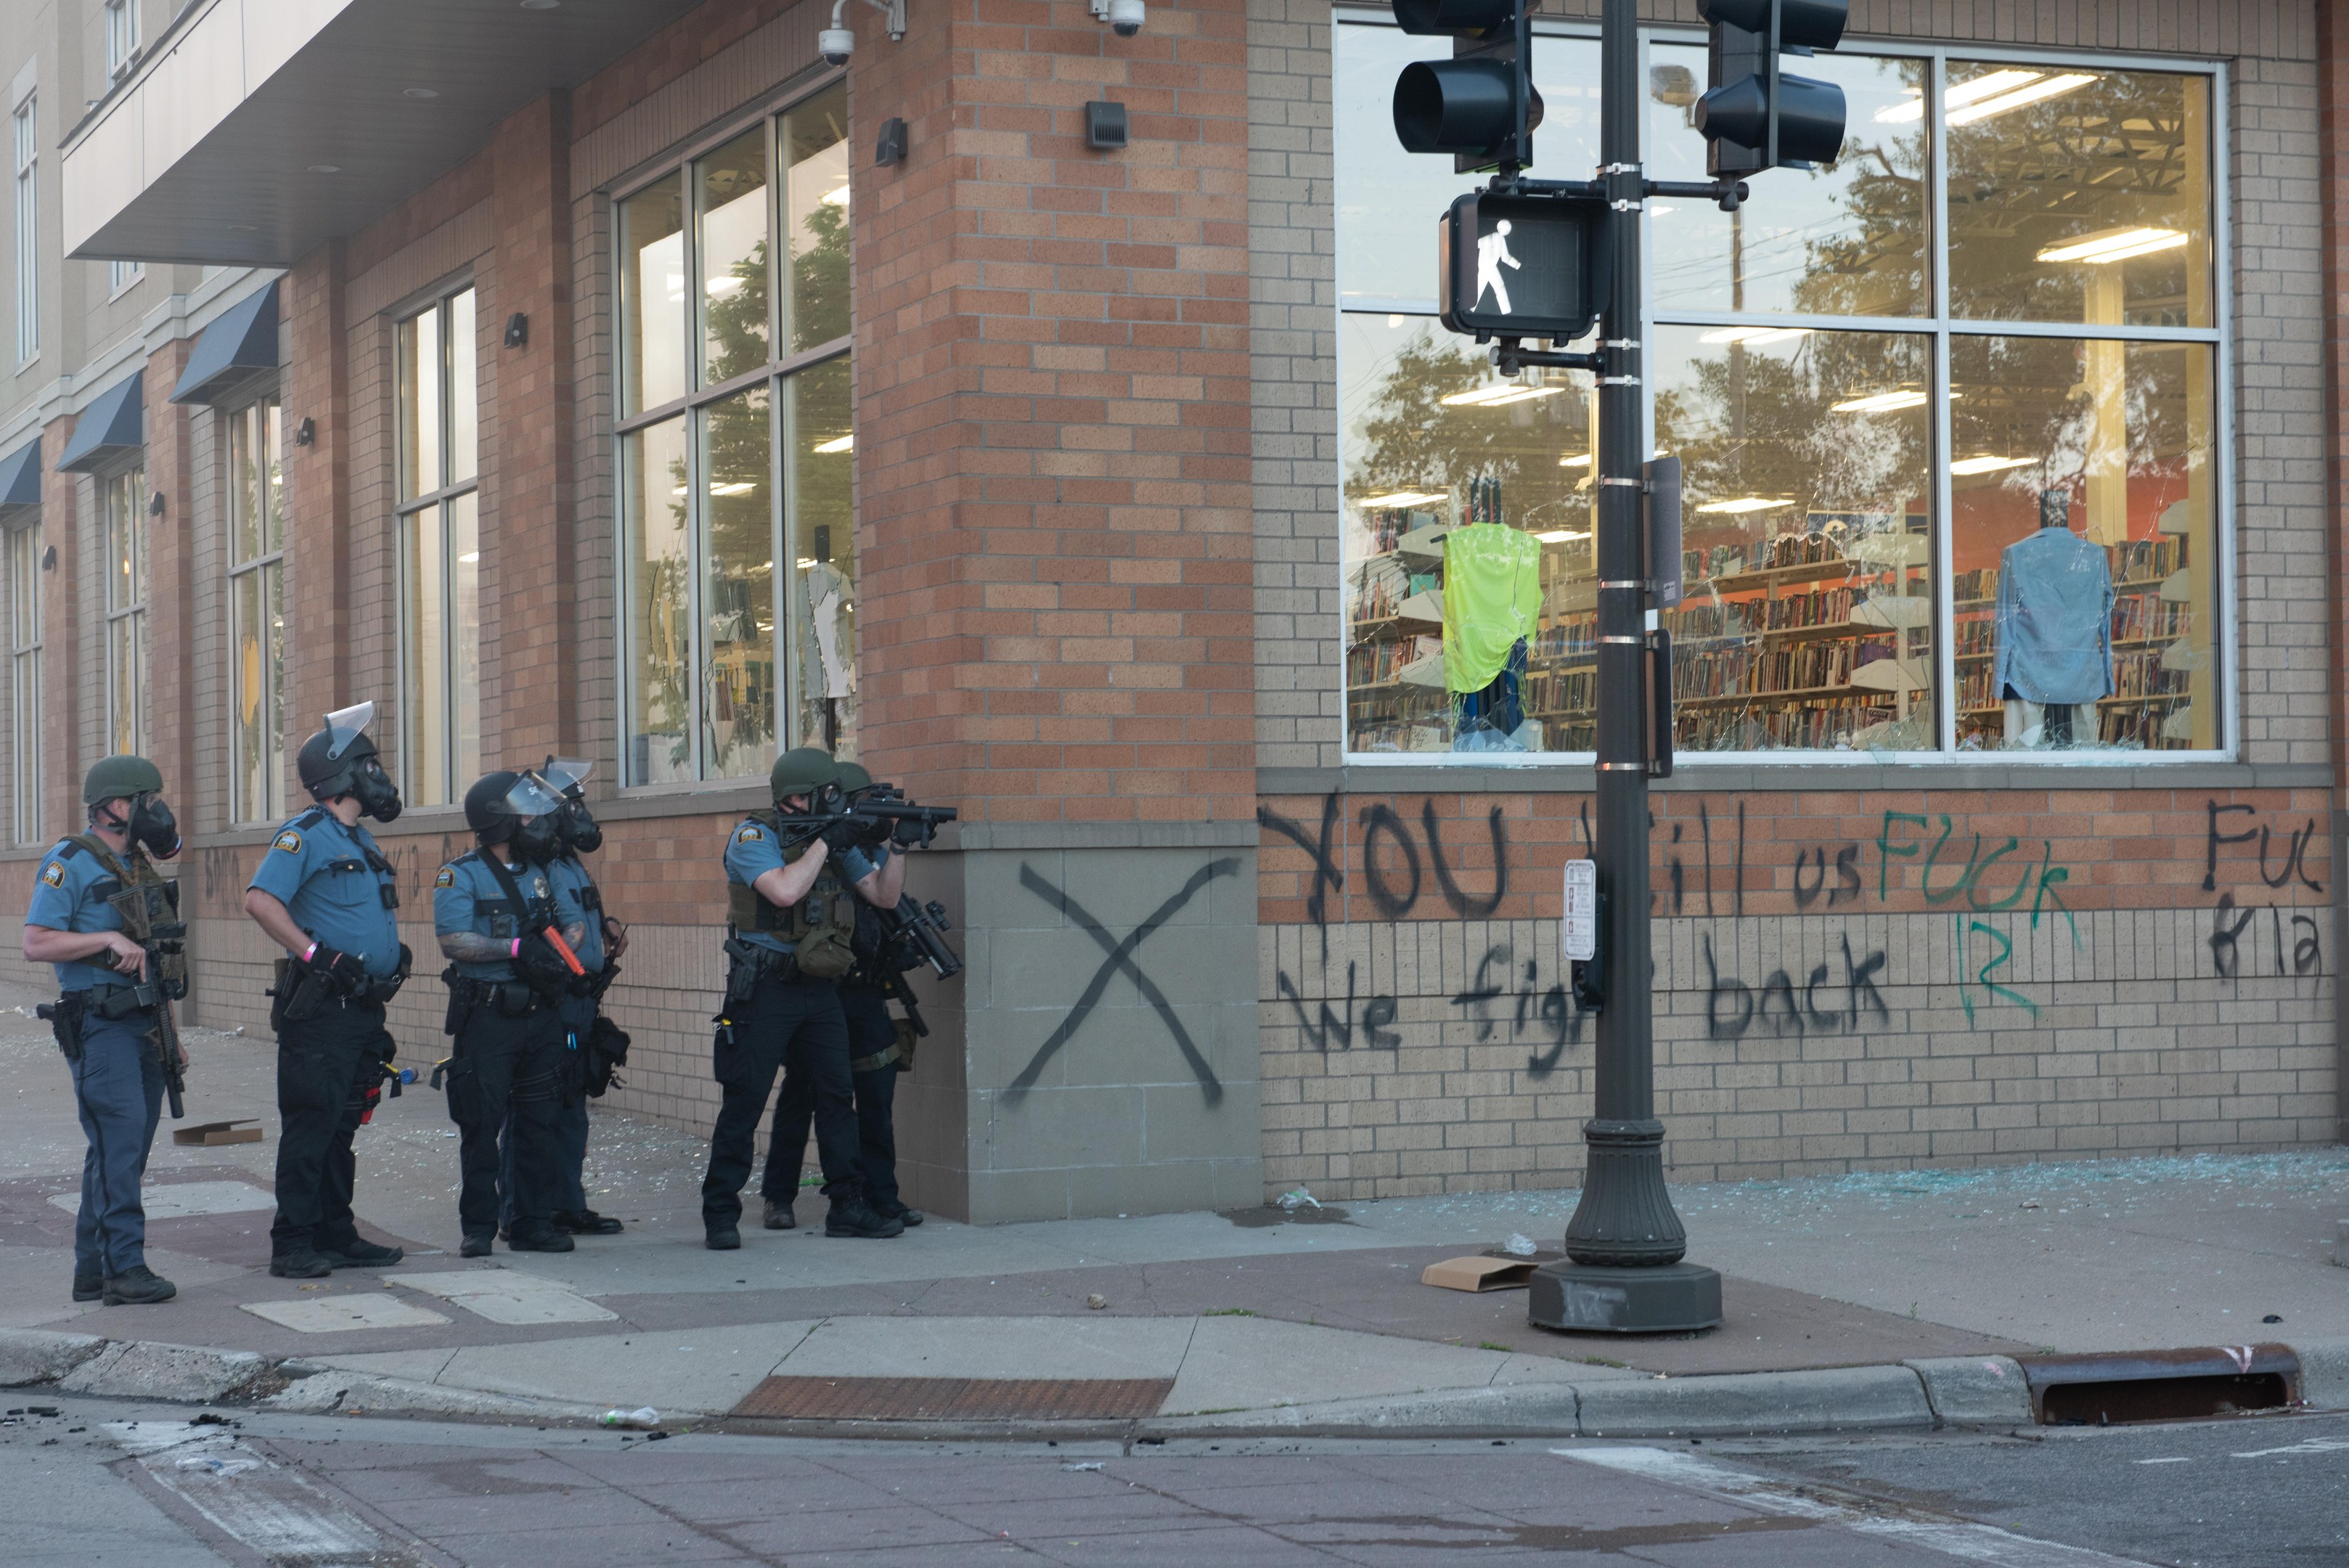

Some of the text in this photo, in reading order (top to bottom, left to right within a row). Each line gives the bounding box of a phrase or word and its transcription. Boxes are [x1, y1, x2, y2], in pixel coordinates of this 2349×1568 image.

[1257, 787, 1860, 955] YOU ill us
[1280, 960, 1402, 1050] We
[1705, 931, 1889, 1038] back
